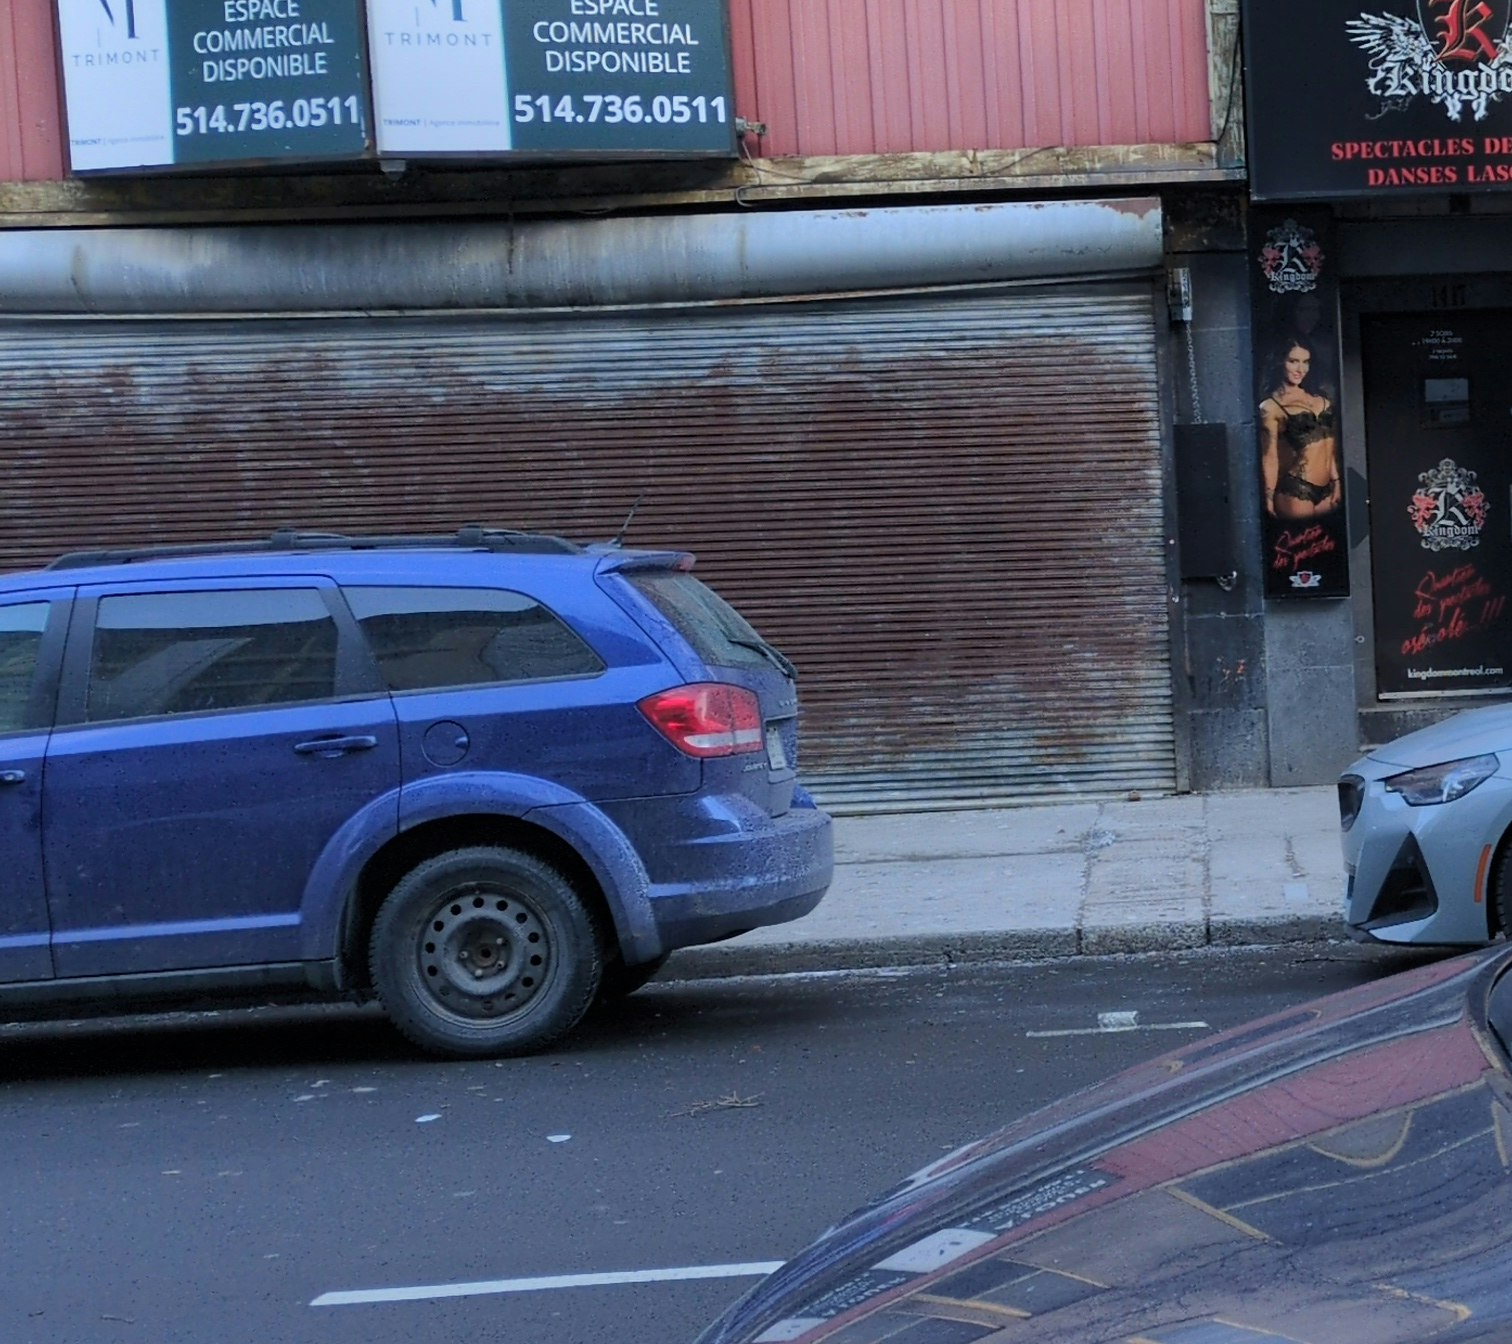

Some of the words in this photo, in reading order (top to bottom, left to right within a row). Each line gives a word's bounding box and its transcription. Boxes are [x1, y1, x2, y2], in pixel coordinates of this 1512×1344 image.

[193, 22, 335, 53] COMMERCIAL
[384, 32, 492, 46] TRIMONT
[533, 21, 698, 46] COMMERCIAL
[72, 49, 160, 67] TRIMONT
[202, 52, 328, 83] DISPONIBLE
[546, 51, 691, 74] DISPONIBLE
[175, 96, 359, 136] 514.736.0511
[514, 94, 726, 124] 514.736.0511
[1331, 137, 1475, 160] SPECTACLES
[1367, 166, 1458, 187] DANSES
[1423, 524, 1479, 537] Kingdom
